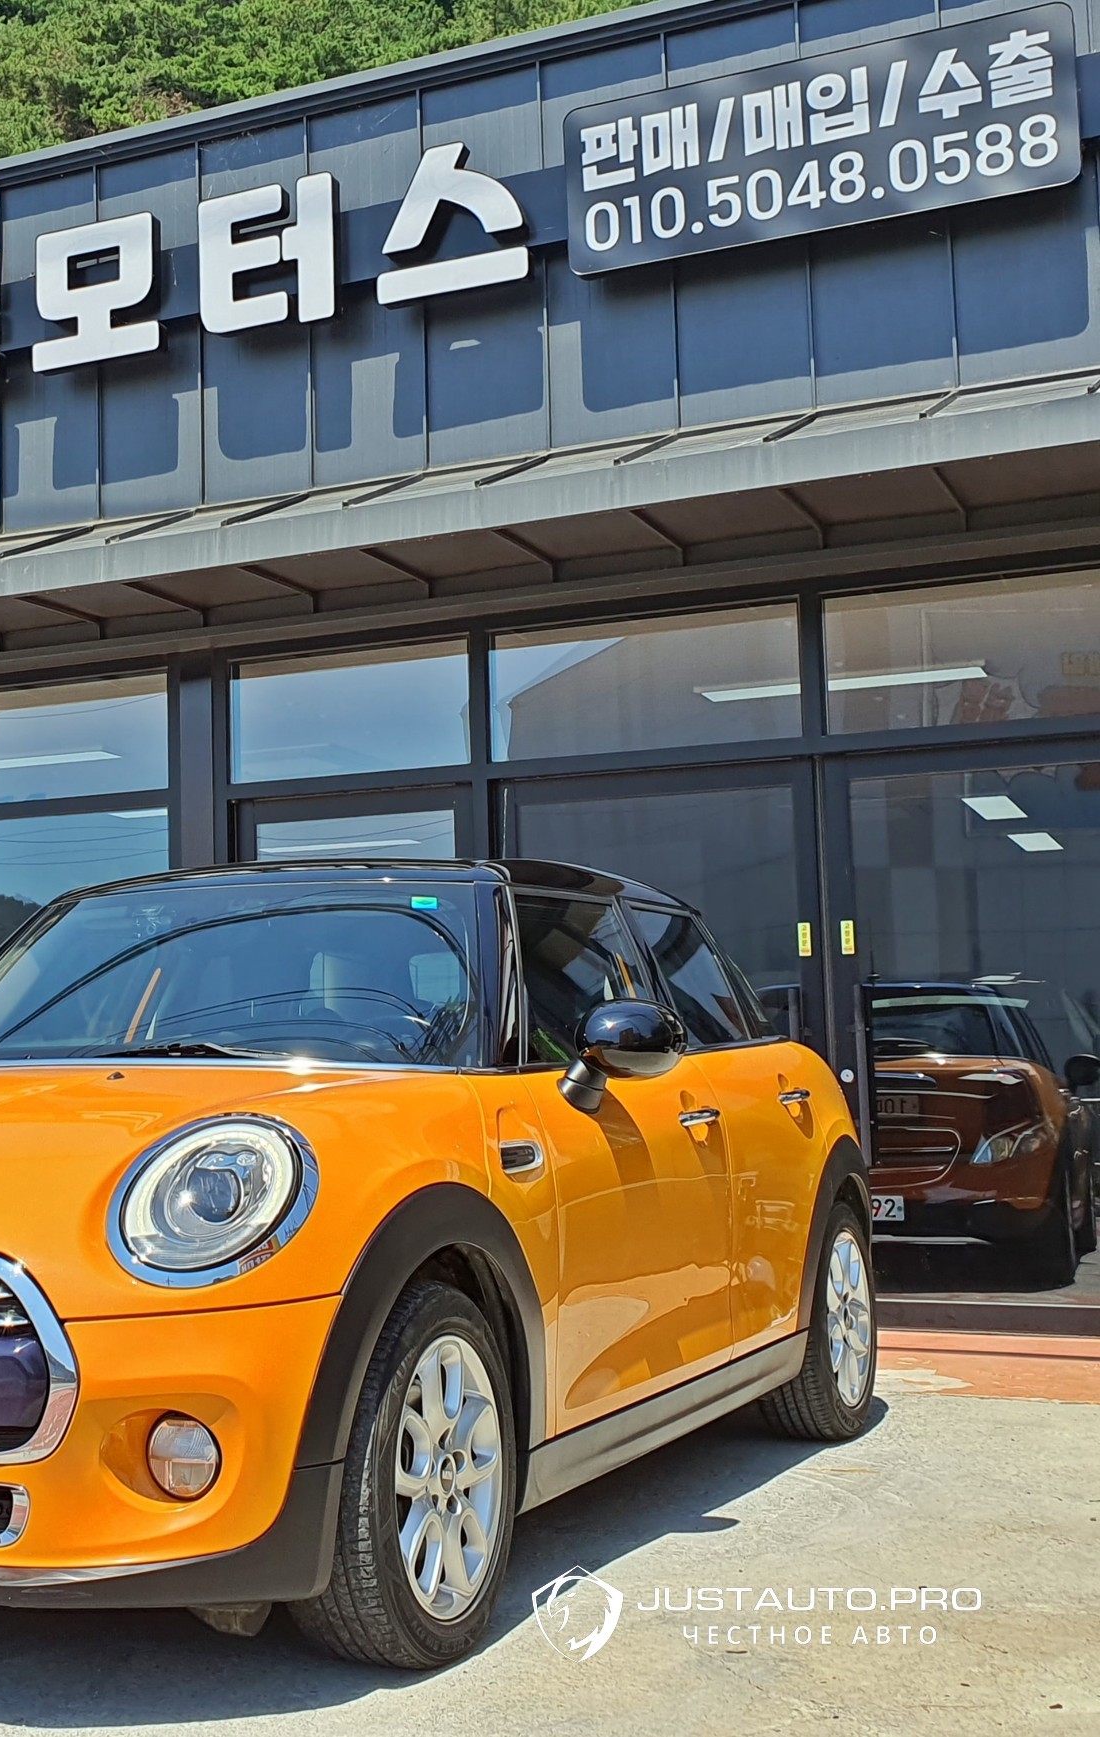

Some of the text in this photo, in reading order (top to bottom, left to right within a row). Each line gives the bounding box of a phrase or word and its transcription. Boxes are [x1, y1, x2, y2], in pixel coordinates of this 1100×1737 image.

[580, 29, 1054, 193] 판매/매입/수출
[584, 114, 1060, 252] 010.5048.0588
[871, 1198, 898, 1218] 92
